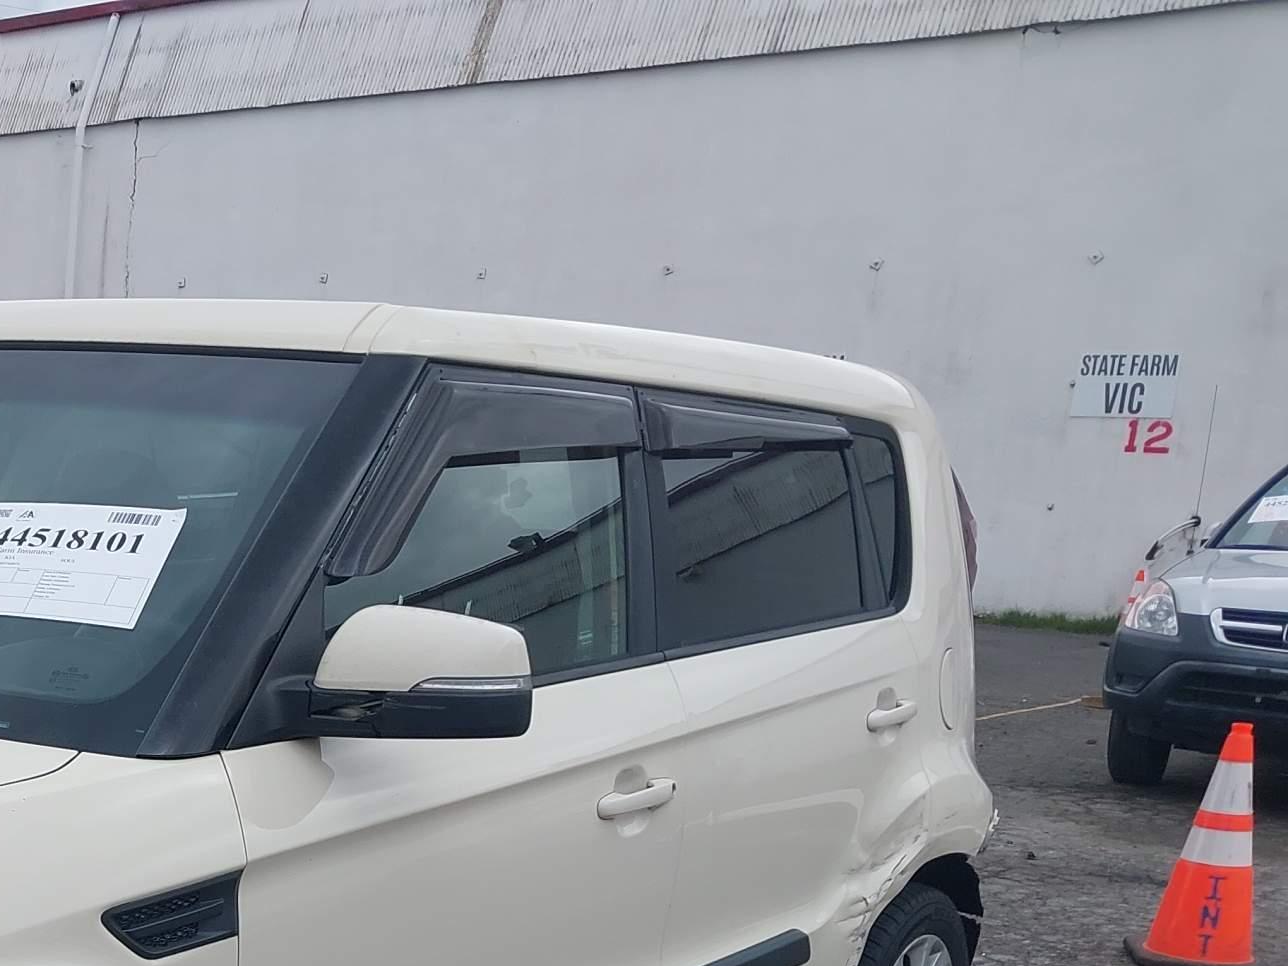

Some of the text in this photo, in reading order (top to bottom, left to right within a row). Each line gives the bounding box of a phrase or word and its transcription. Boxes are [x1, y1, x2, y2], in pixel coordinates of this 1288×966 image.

[1080, 354, 1179, 376] STATE FARM
[1104, 382, 1145, 414] VIC
[1124, 419, 1174, 454] 12
[1197, 875, 1228, 958] INT
